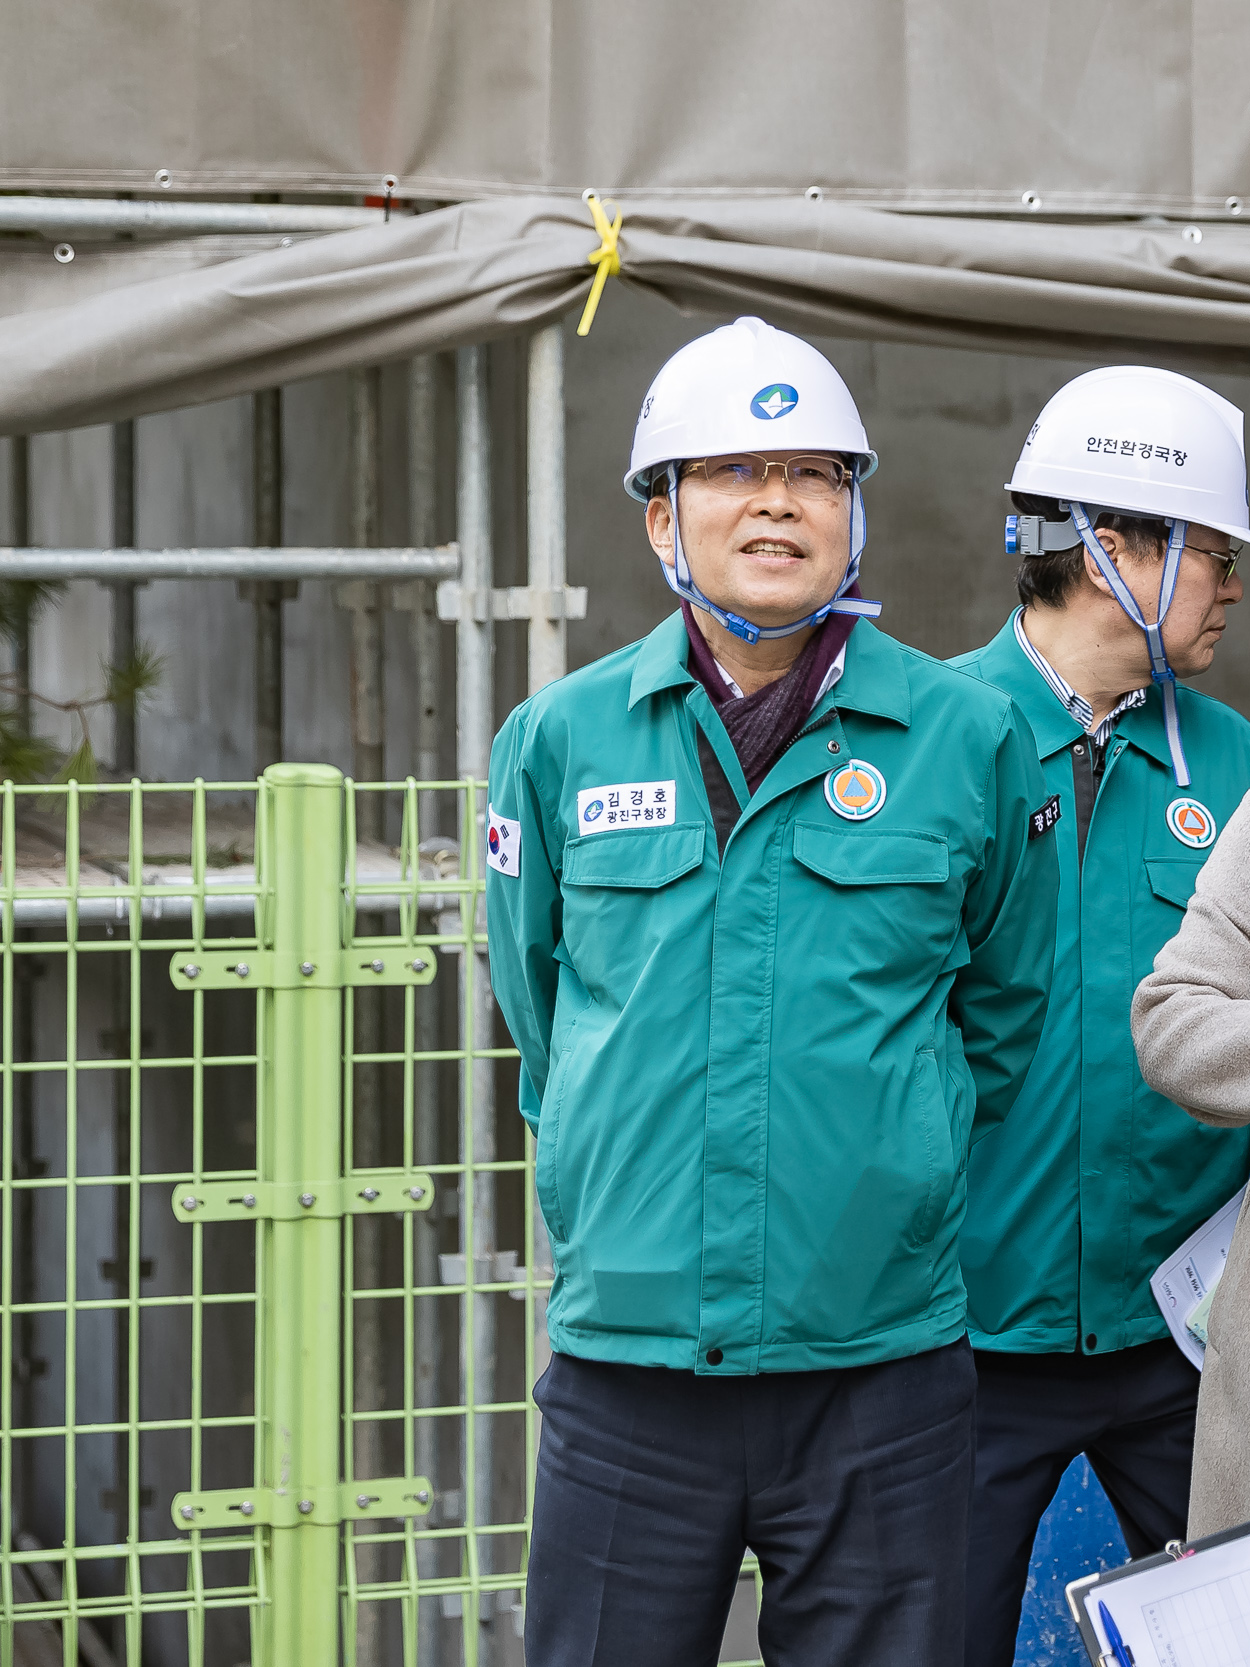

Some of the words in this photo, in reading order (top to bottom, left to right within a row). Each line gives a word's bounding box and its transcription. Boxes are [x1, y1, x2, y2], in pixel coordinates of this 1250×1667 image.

[1086, 436, 1188, 467] 안전환경국장
[607, 806, 667, 824] 광진구청장
[1034, 801, 1059, 832] 광진구
